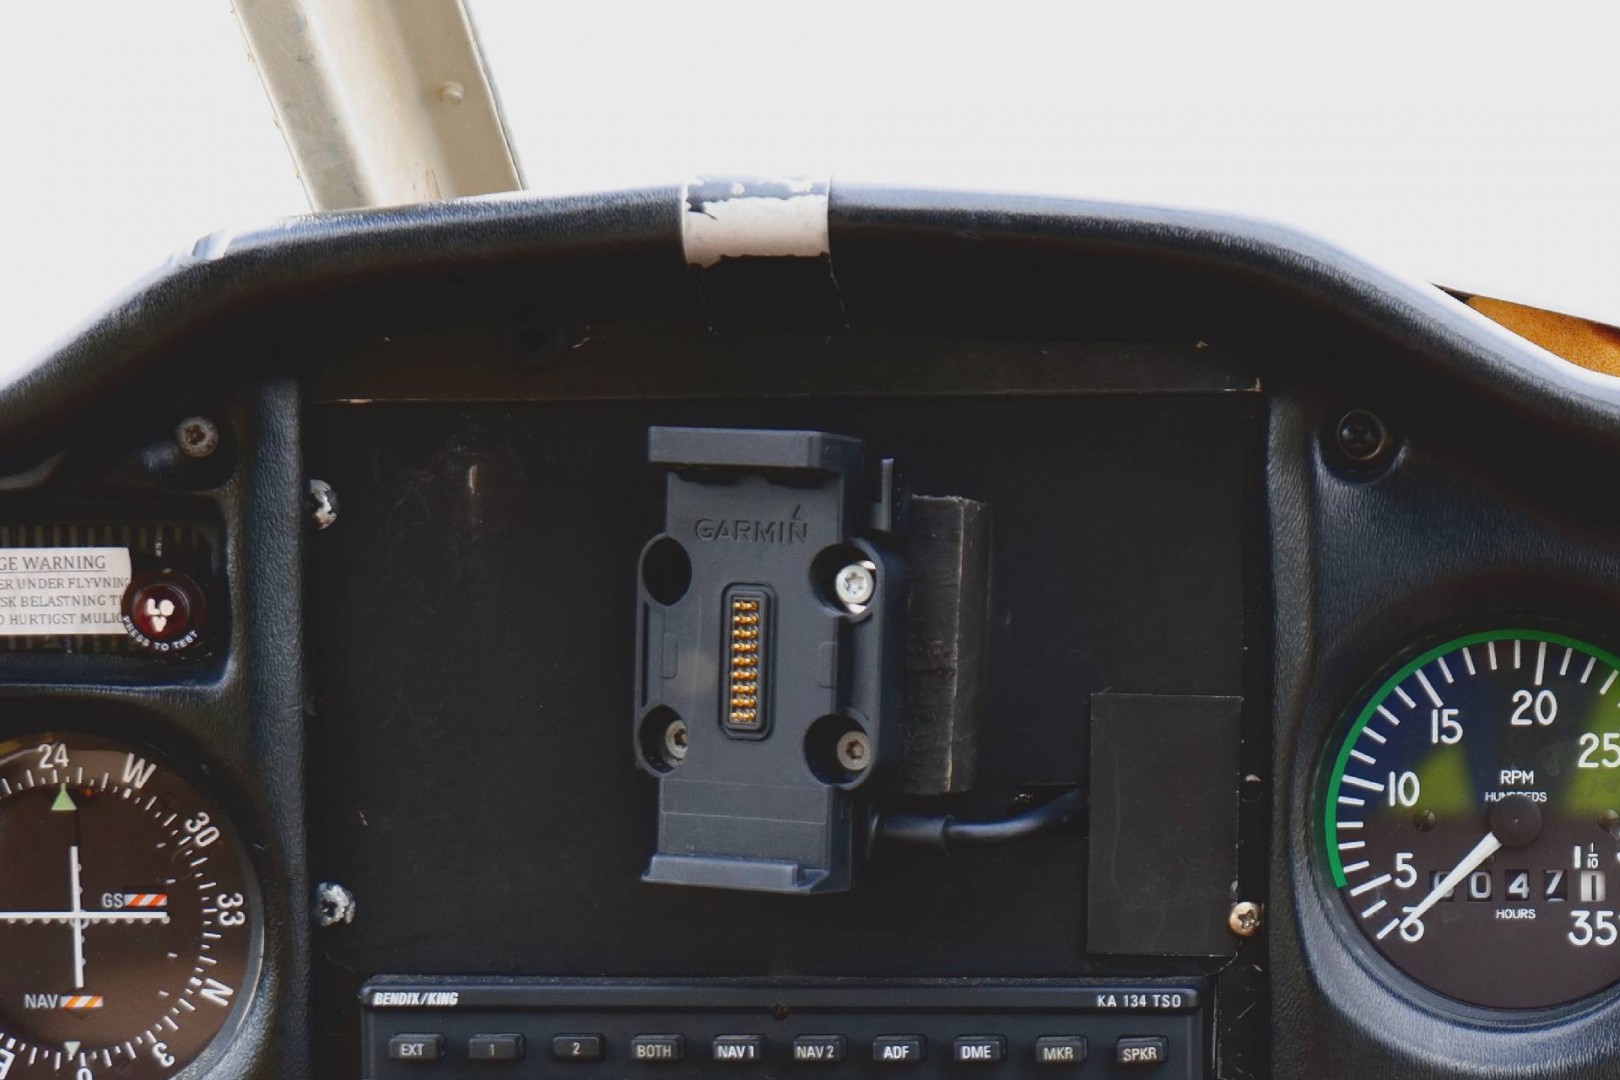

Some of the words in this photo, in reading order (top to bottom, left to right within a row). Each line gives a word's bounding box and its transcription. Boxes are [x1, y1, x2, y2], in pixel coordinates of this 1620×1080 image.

[694, 517, 808, 545] GARMIN
[22, 555, 106, 570] WARNING
[17, 578, 65, 589] UNDER
[20, 595, 106, 607] BELASTNING
[10, 613, 76, 625] HURTIGST
[123, 615, 151, 647] PRESS
[154, 642, 170, 651] TO
[172, 630, 198, 649] TEST
[1510, 689, 1558, 726] 20
[1431, 709, 1464, 745] 15
[1500, 770, 1535, 784] RPM
[1388, 771, 1421, 807] 10
[1496, 908, 1537, 920] HOURS
[1568, 910, 1618, 946] 35
[373, 991, 459, 1007] BENDIX/KING
[1097, 994, 1117, 1008] KA
[1123, 994, 1147, 1008] 134
[1152, 994, 1181, 1008] TSO
[637, 1043, 672, 1058] BOTH
[883, 1045, 910, 1060] ADF
[961, 1045, 991, 1060] DME
[1123, 1047, 1157, 1062] SPKR
